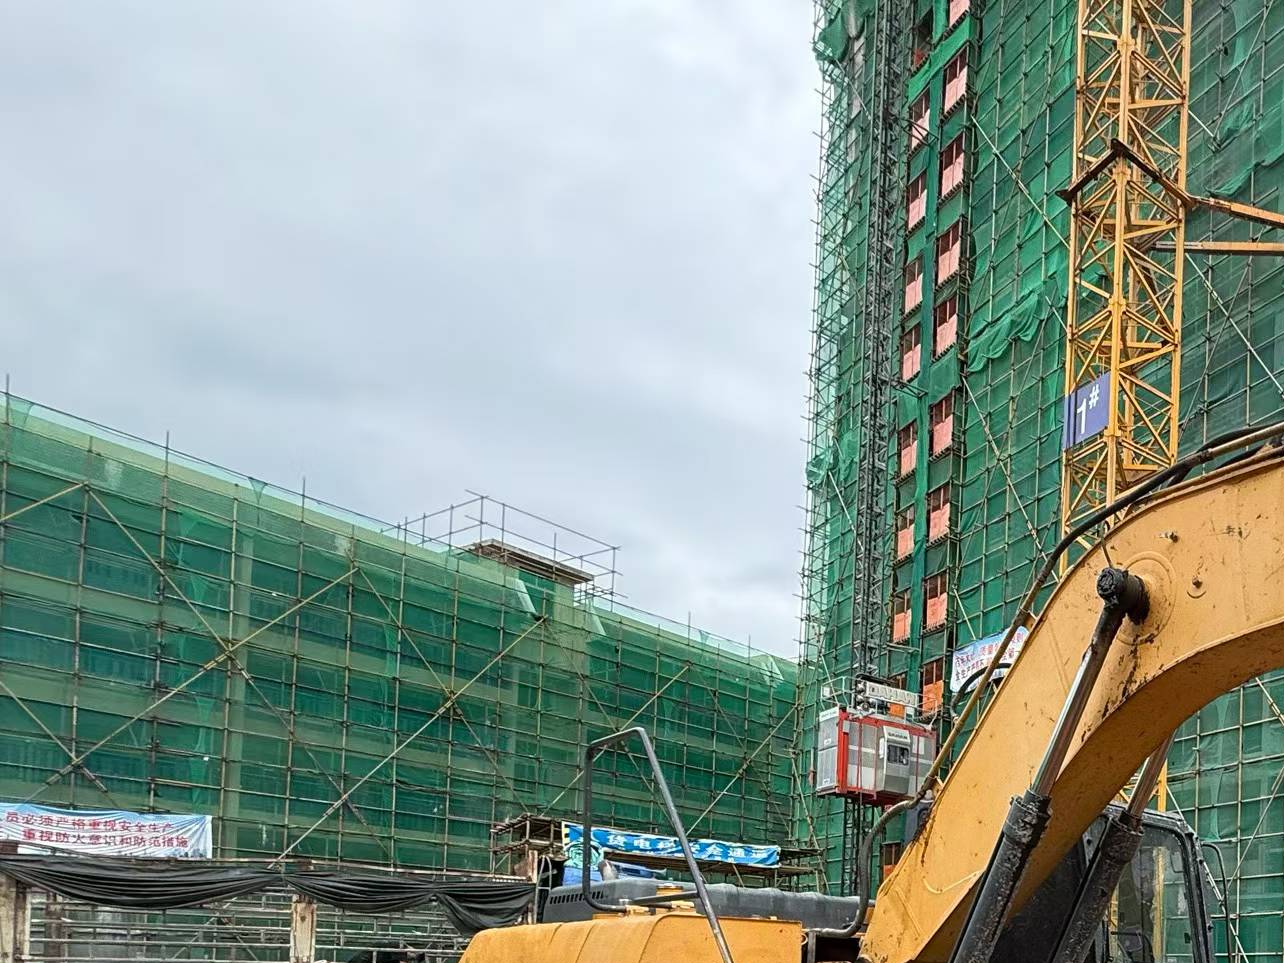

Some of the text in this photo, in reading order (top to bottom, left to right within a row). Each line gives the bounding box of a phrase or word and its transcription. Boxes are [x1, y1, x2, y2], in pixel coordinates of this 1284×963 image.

[0, 811, 174, 833] 员必须严格重视安全生产
